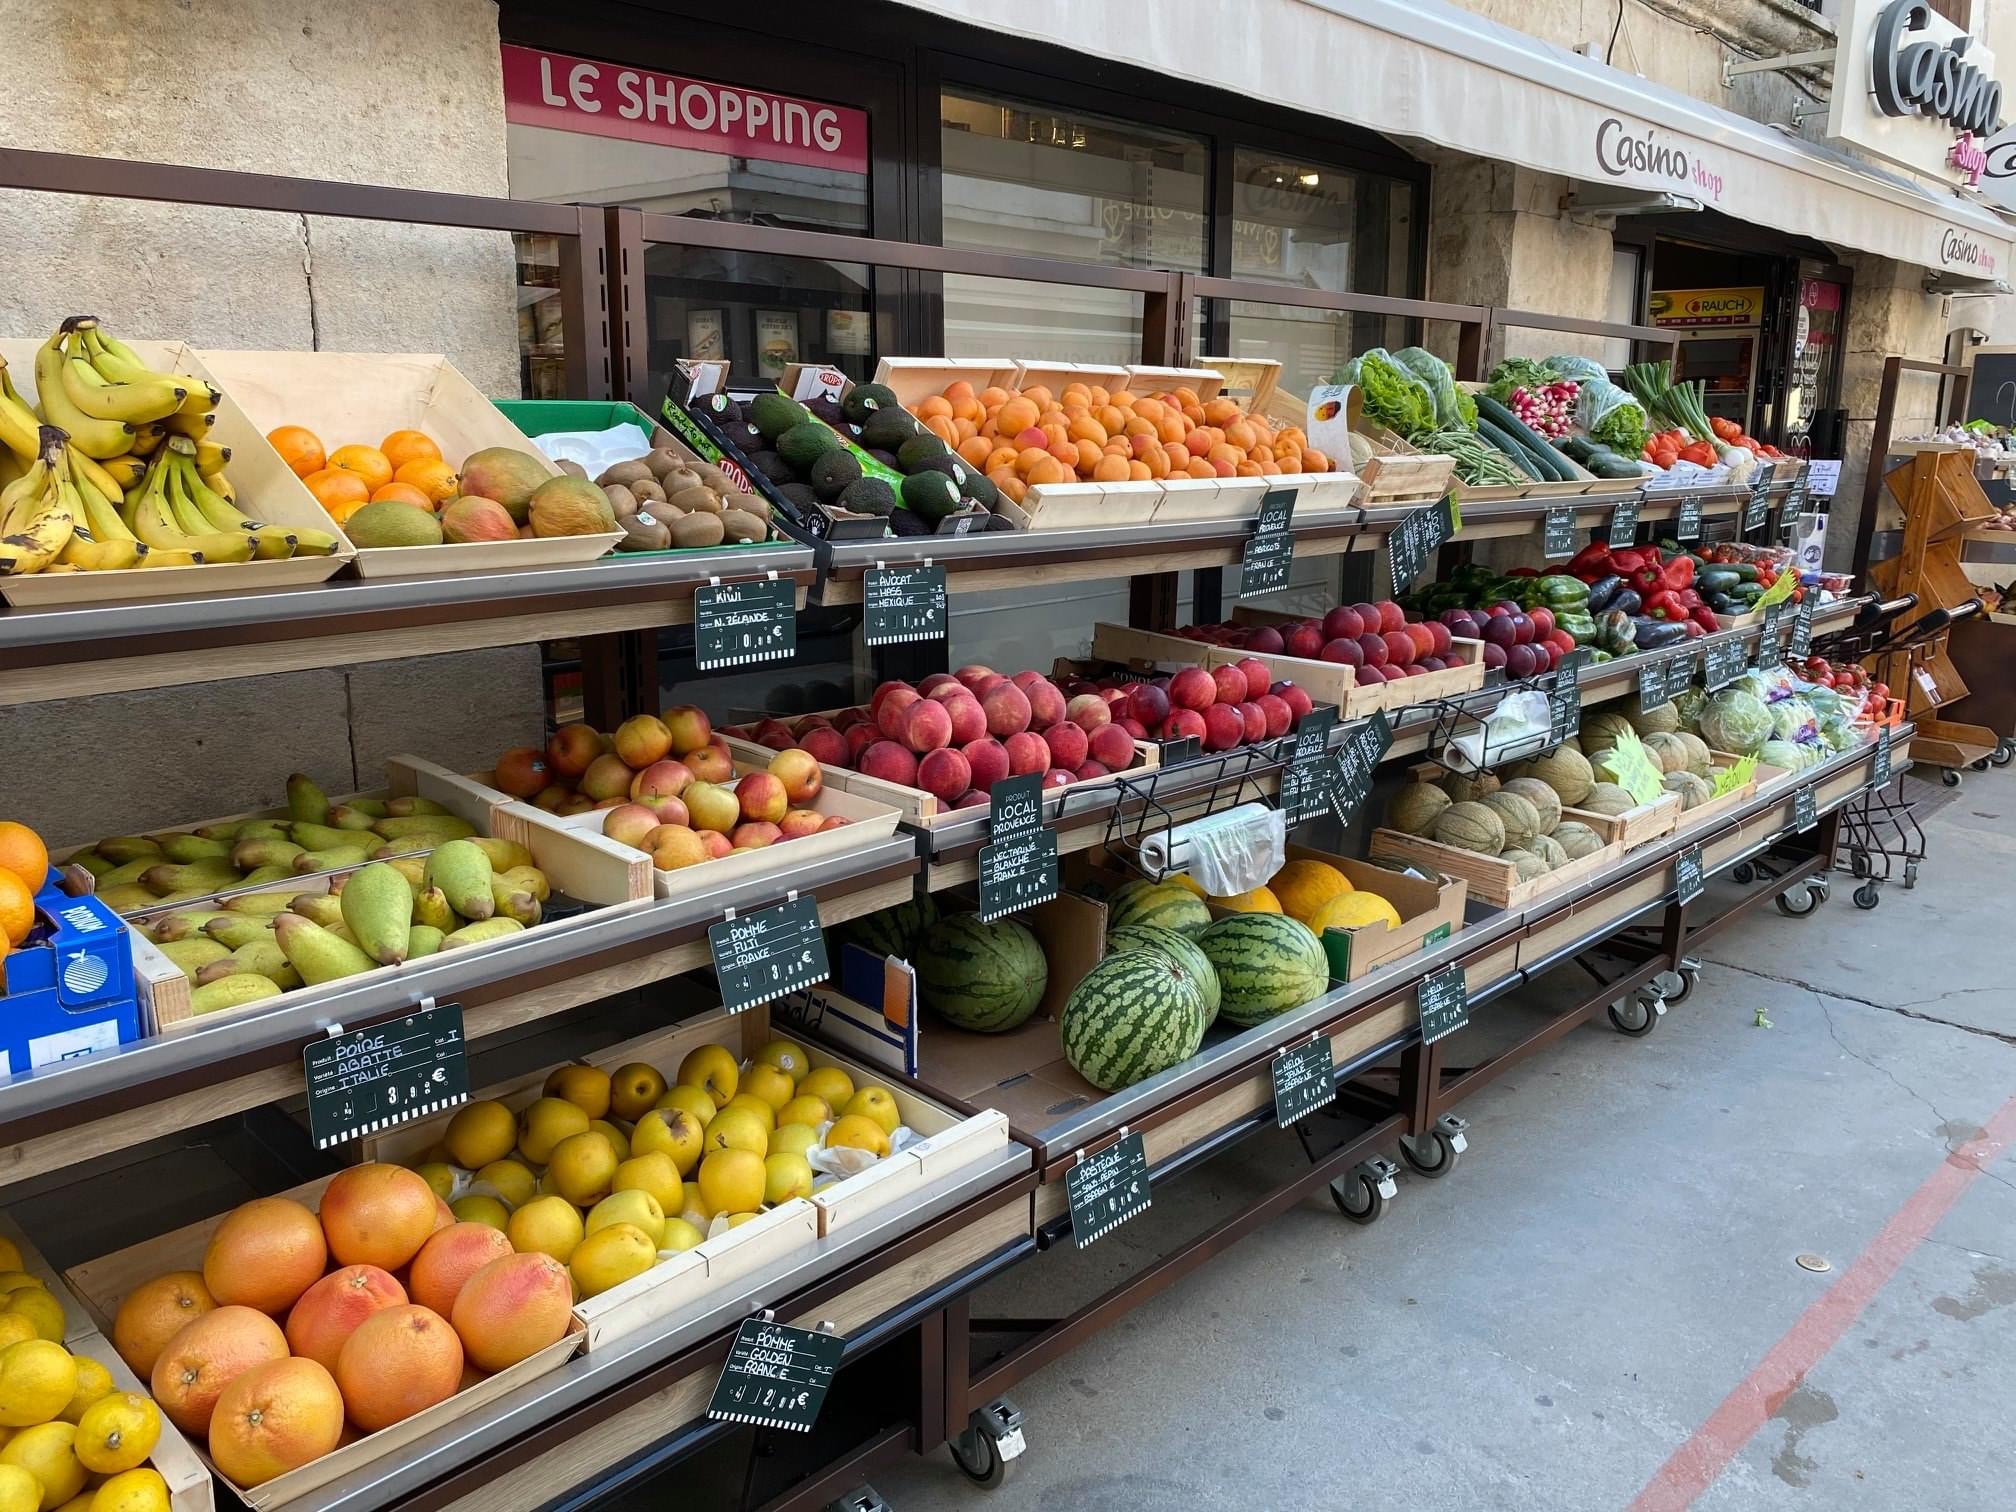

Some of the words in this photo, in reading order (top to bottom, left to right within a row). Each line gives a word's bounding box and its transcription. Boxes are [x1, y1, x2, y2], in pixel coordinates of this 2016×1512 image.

[1873, 0, 2002, 137] Casino
[541, 57, 601, 113] LE
[617, 71, 842, 151] SHOPPING
[1596, 118, 1688, 180] Casino
[1692, 159, 1723, 201] shop
[1941, 228, 1978, 265] Casino
[1702, 300, 1745, 312] RAUCH
[819, 373, 842, 386] TROPS
[1262, 510, 1287, 524] LOCAL
[1430, 510, 1443, 545] LOCAL
[880, 574, 913, 587] AVOCAT
[879, 596, 915, 608] MEXIQUE
[880, 586, 903, 598] HASS
[1299, 732, 1324, 747] LOCAL
[1365, 725, 1380, 758] LOCAL
[1005, 790, 1031, 802] PRODUIT
[998, 799, 1038, 821] LOCAL
[993, 813, 1037, 836] PROVENCE
[993, 842, 1037, 863] NECTARINE
[993, 853, 1030, 873] BLANCHE
[730, 920, 767, 942] POMME
[733, 938, 760, 955] FUJI
[736, 947, 770, 967] FRANCE
[337, 1045, 403, 1076] ABATTE
[756, 1331, 796, 1352] POMME
[750, 1347, 793, 1366] GOLDEN
[744, 1360, 790, 1380] FRANCE
